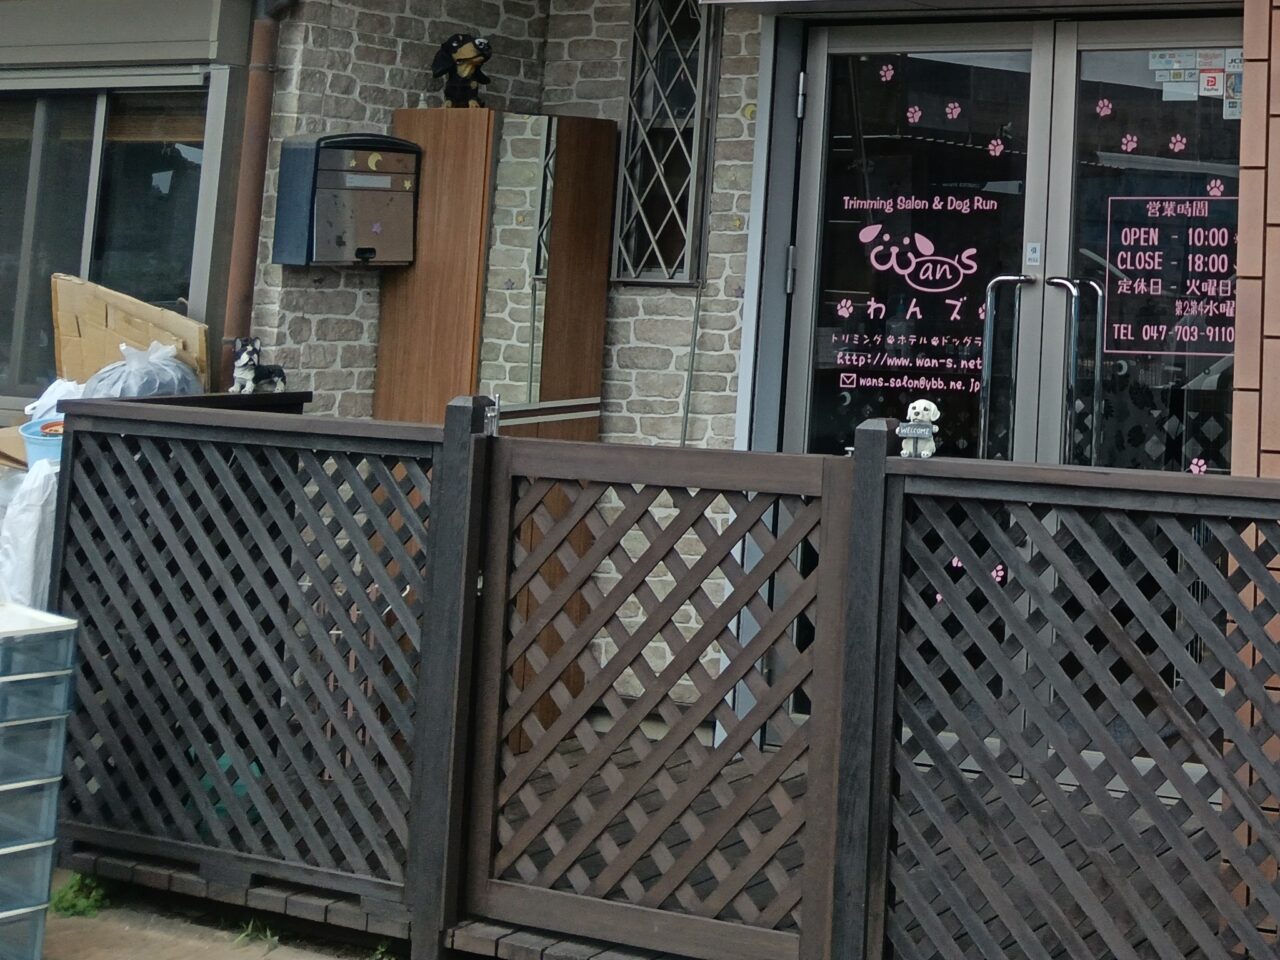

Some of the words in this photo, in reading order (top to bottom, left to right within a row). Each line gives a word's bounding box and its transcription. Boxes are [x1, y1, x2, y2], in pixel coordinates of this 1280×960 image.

[843, 196, 894, 213] Trimming
[897, 196, 928, 209] Salon
[932, 197, 944, 209] &
[947, 197, 969, 213] Dog
[974, 197, 998, 209] Run
[1146, 201, 1208, 217] 営業時間
[1121, 228, 1159, 246] OPEN
[1188, 228, 1228, 246] 10:00
[1117, 251, 1163, 270] CLOSE
[1187, 254, 1228, 273] 18:00
[1117, 278, 1162, 295] 定休日
[866, 296, 967, 321] わんズ
[831, 333, 882, 345] トリミング
[897, 334, 928, 345] ホテル
[1113, 324, 1135, 340] TEL
[1142, 324, 1235, 343] 047-703-9110
